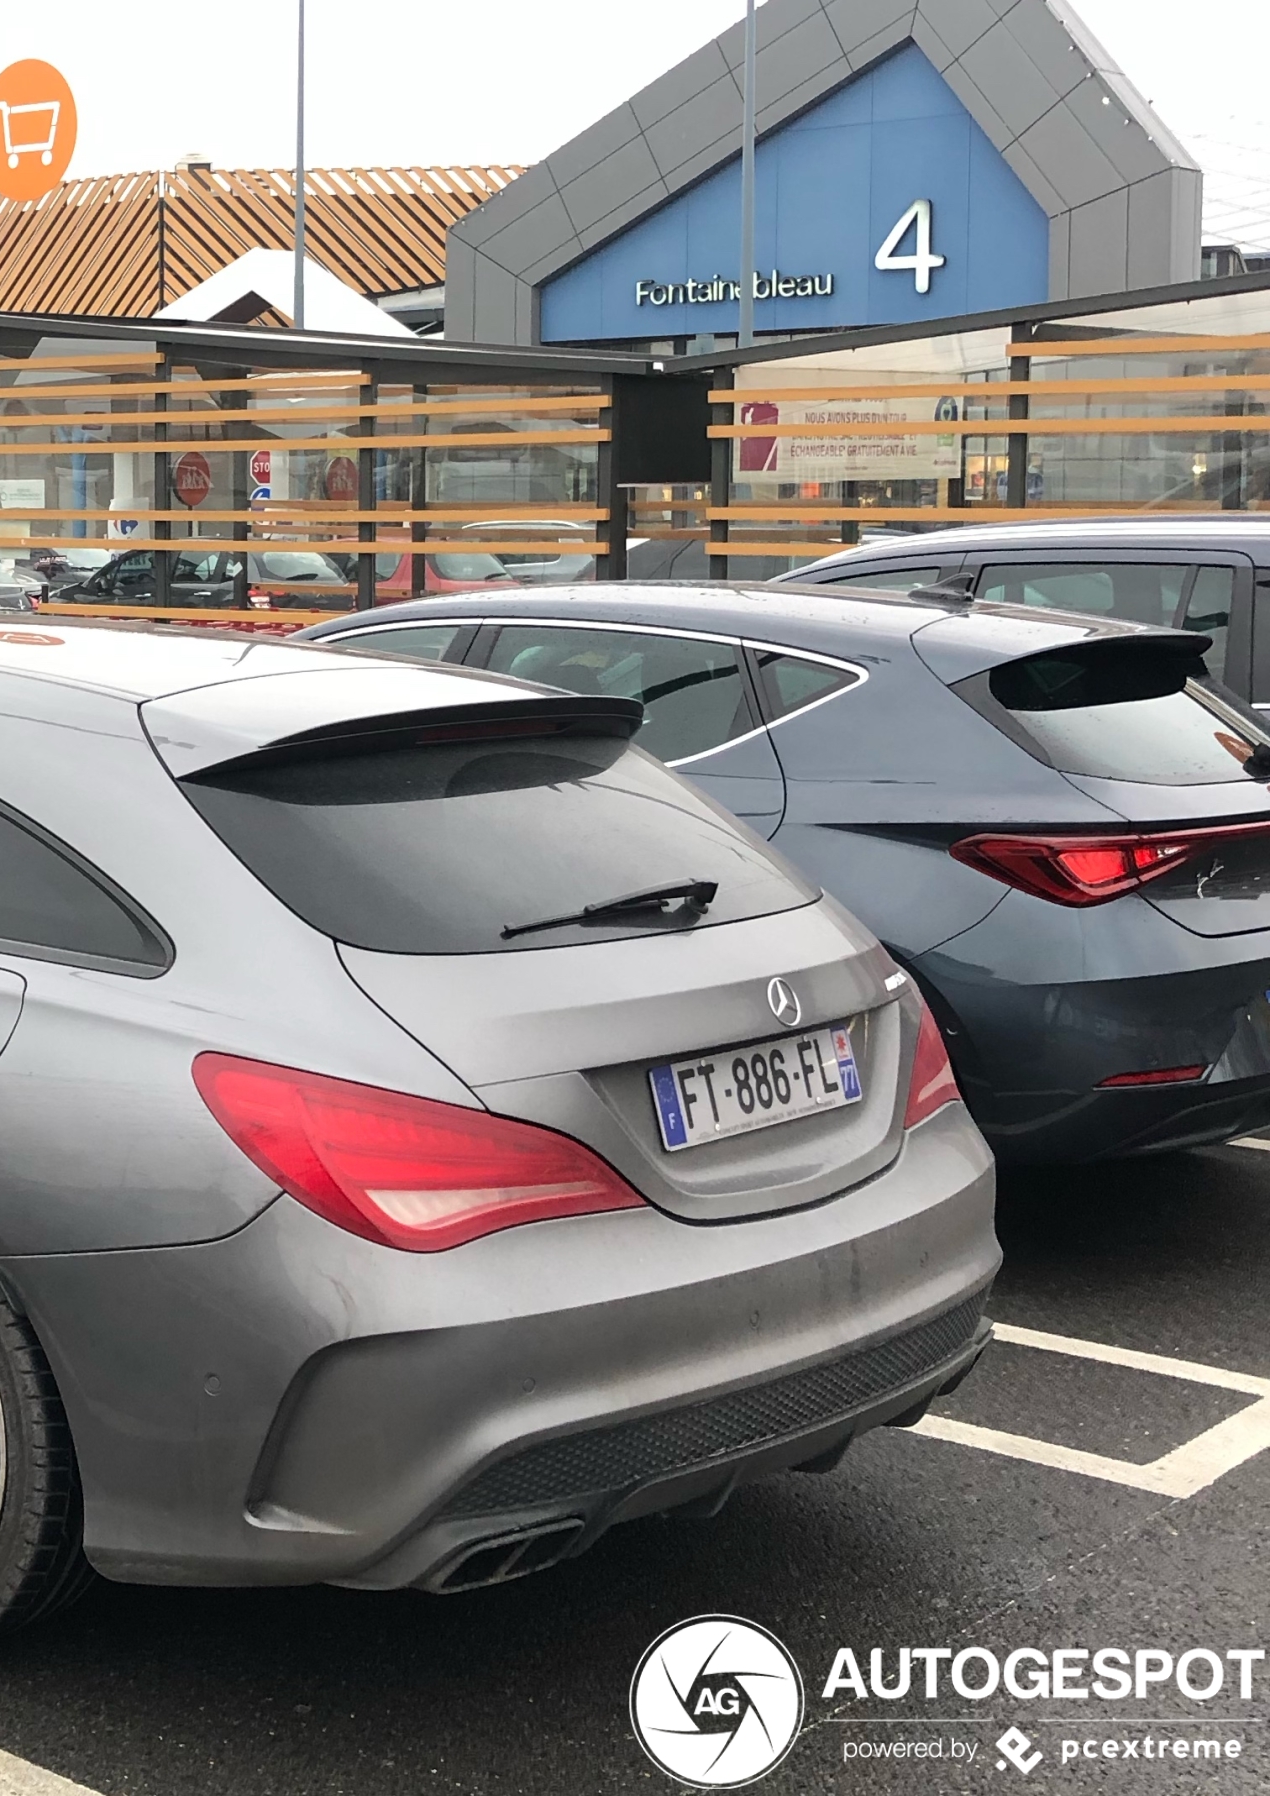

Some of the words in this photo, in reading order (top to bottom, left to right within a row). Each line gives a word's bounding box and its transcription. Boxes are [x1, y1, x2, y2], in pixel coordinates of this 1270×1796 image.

[874, 198, 946, 295] 4
[805, 412, 826, 423] NOUS
[827, 412, 851, 423] AVONS
[852, 412, 872, 423] PLUS
[847, 444, 899, 456] GRATUITEMENT
[254, 462, 271, 473] STO
[677, 1038, 839, 1130] FT-886-FL
[840, 1064, 856, 1092] 77
[668, 1112, 676, 1130] F
